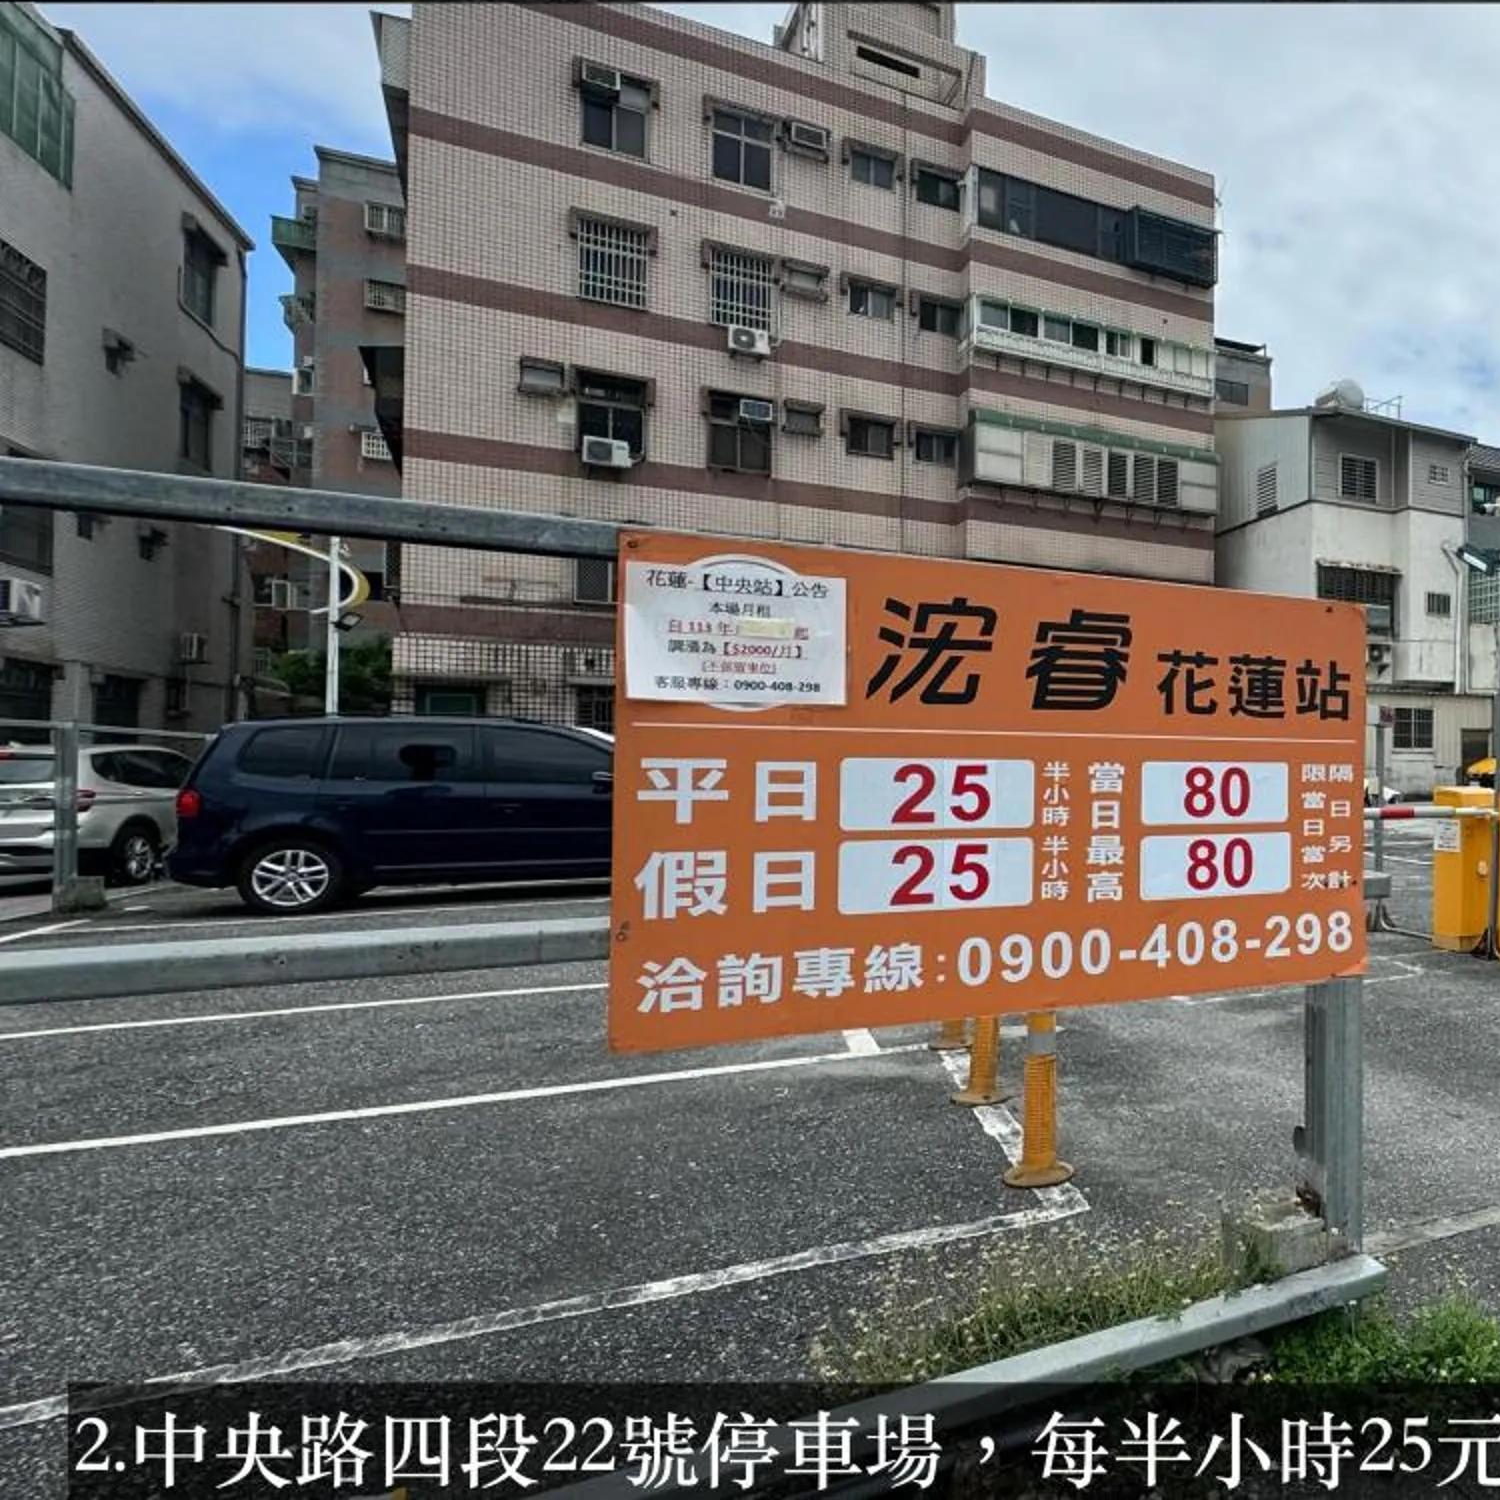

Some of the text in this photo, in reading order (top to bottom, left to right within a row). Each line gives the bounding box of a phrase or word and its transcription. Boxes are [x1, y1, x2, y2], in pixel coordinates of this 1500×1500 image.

[866, 596, 1351, 722] 浤睿 花蓮站
[636, 757, 818, 824] 平日
[890, 763, 992, 825] 25
[1041, 761, 1071, 828] 半小時
[1182, 766, 1252, 819] 80
[1086, 761, 1124, 903] 當日最高
[1185, 837, 1254, 890] 80
[634, 850, 817, 919] 假日
[890, 842, 992, 906] 25
[1041, 835, 1071, 902] 半小時
